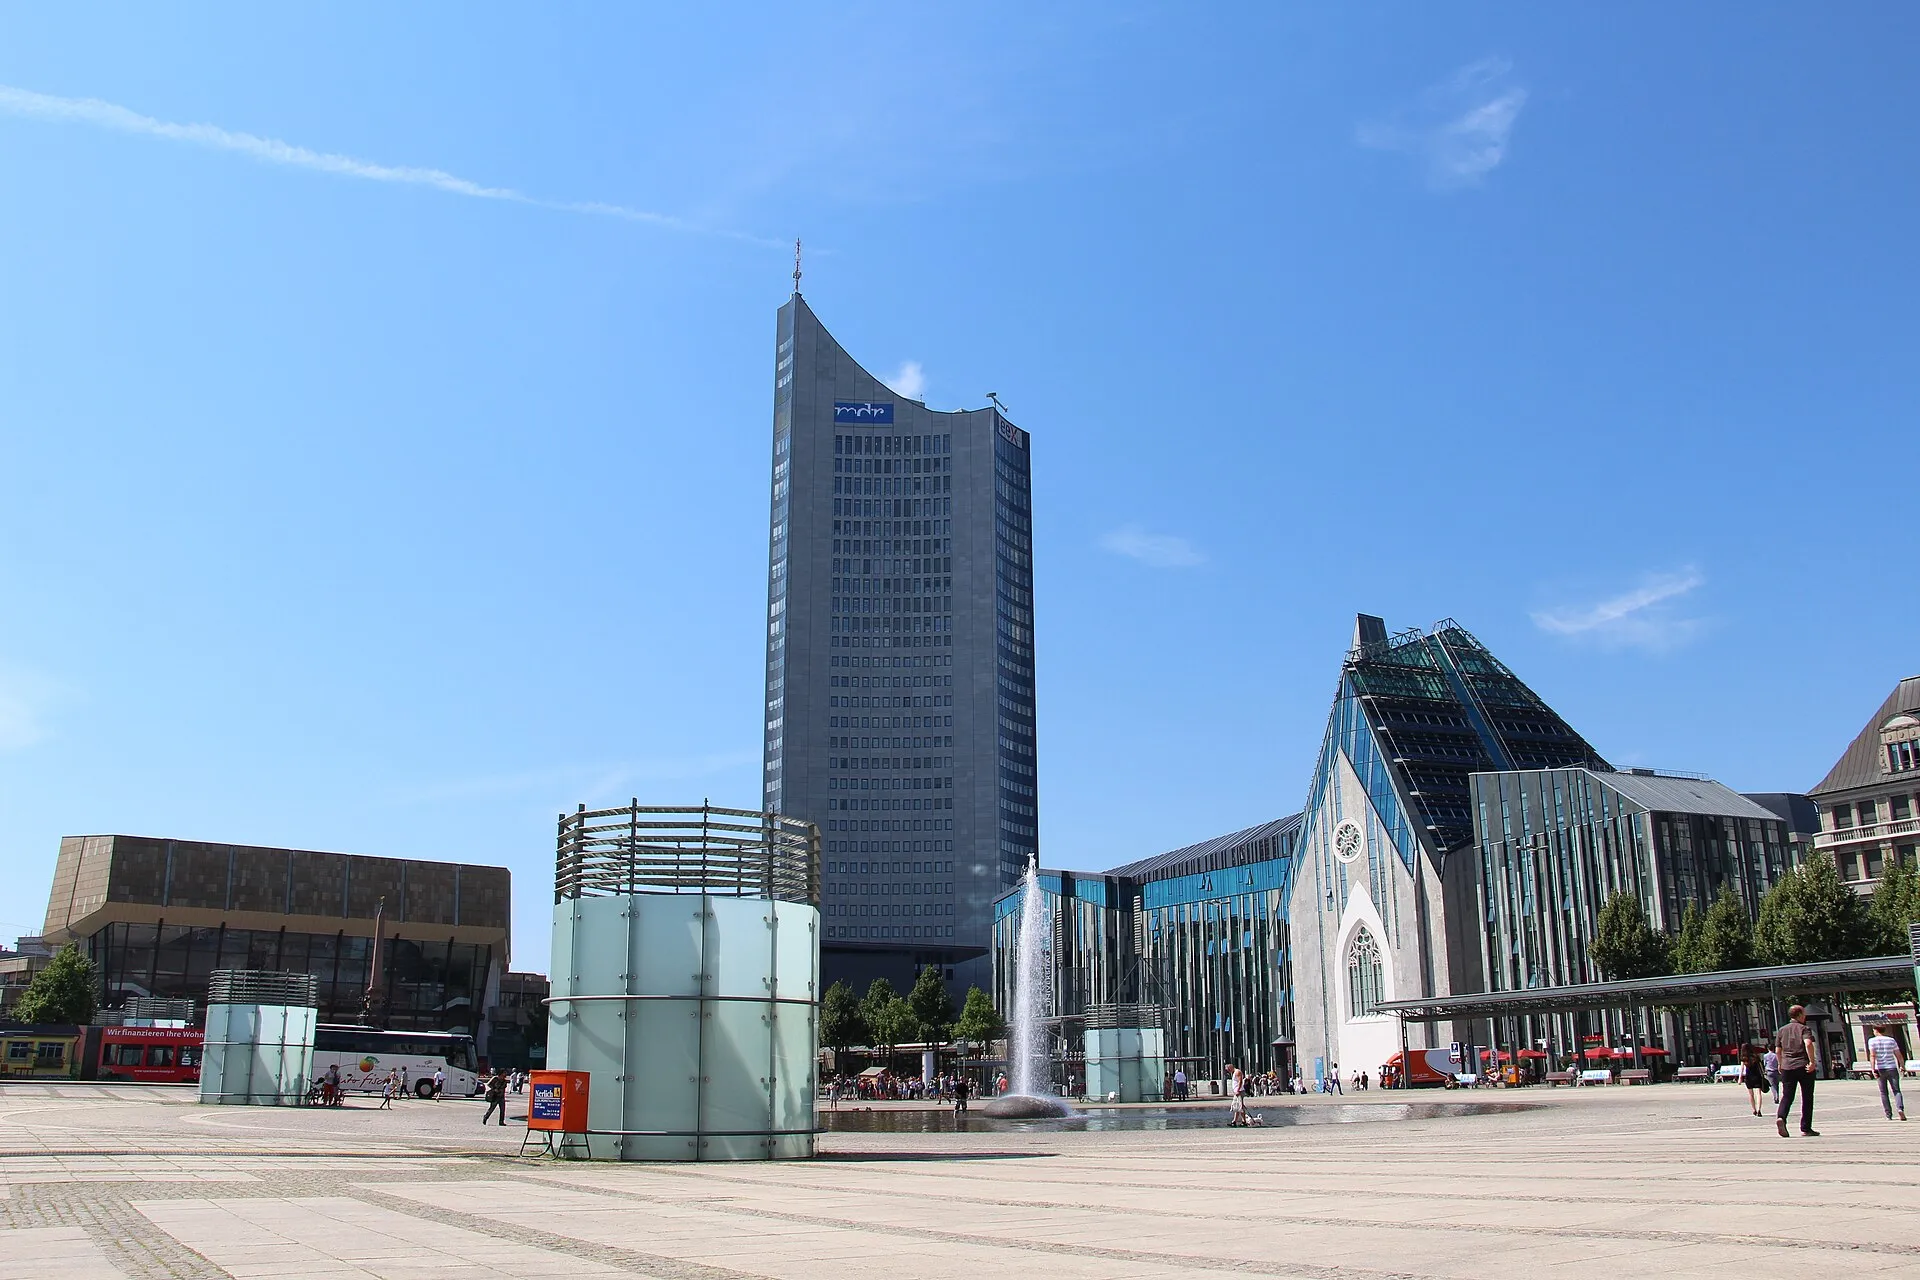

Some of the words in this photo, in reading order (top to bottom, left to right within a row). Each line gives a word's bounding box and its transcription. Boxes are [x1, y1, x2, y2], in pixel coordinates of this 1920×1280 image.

[835, 403, 885, 417] mdr
[122, 1029, 165, 1037] finanzieren
[166, 1030, 181, 1038] Ihre
[535, 1089, 554, 1097] Nerlich
